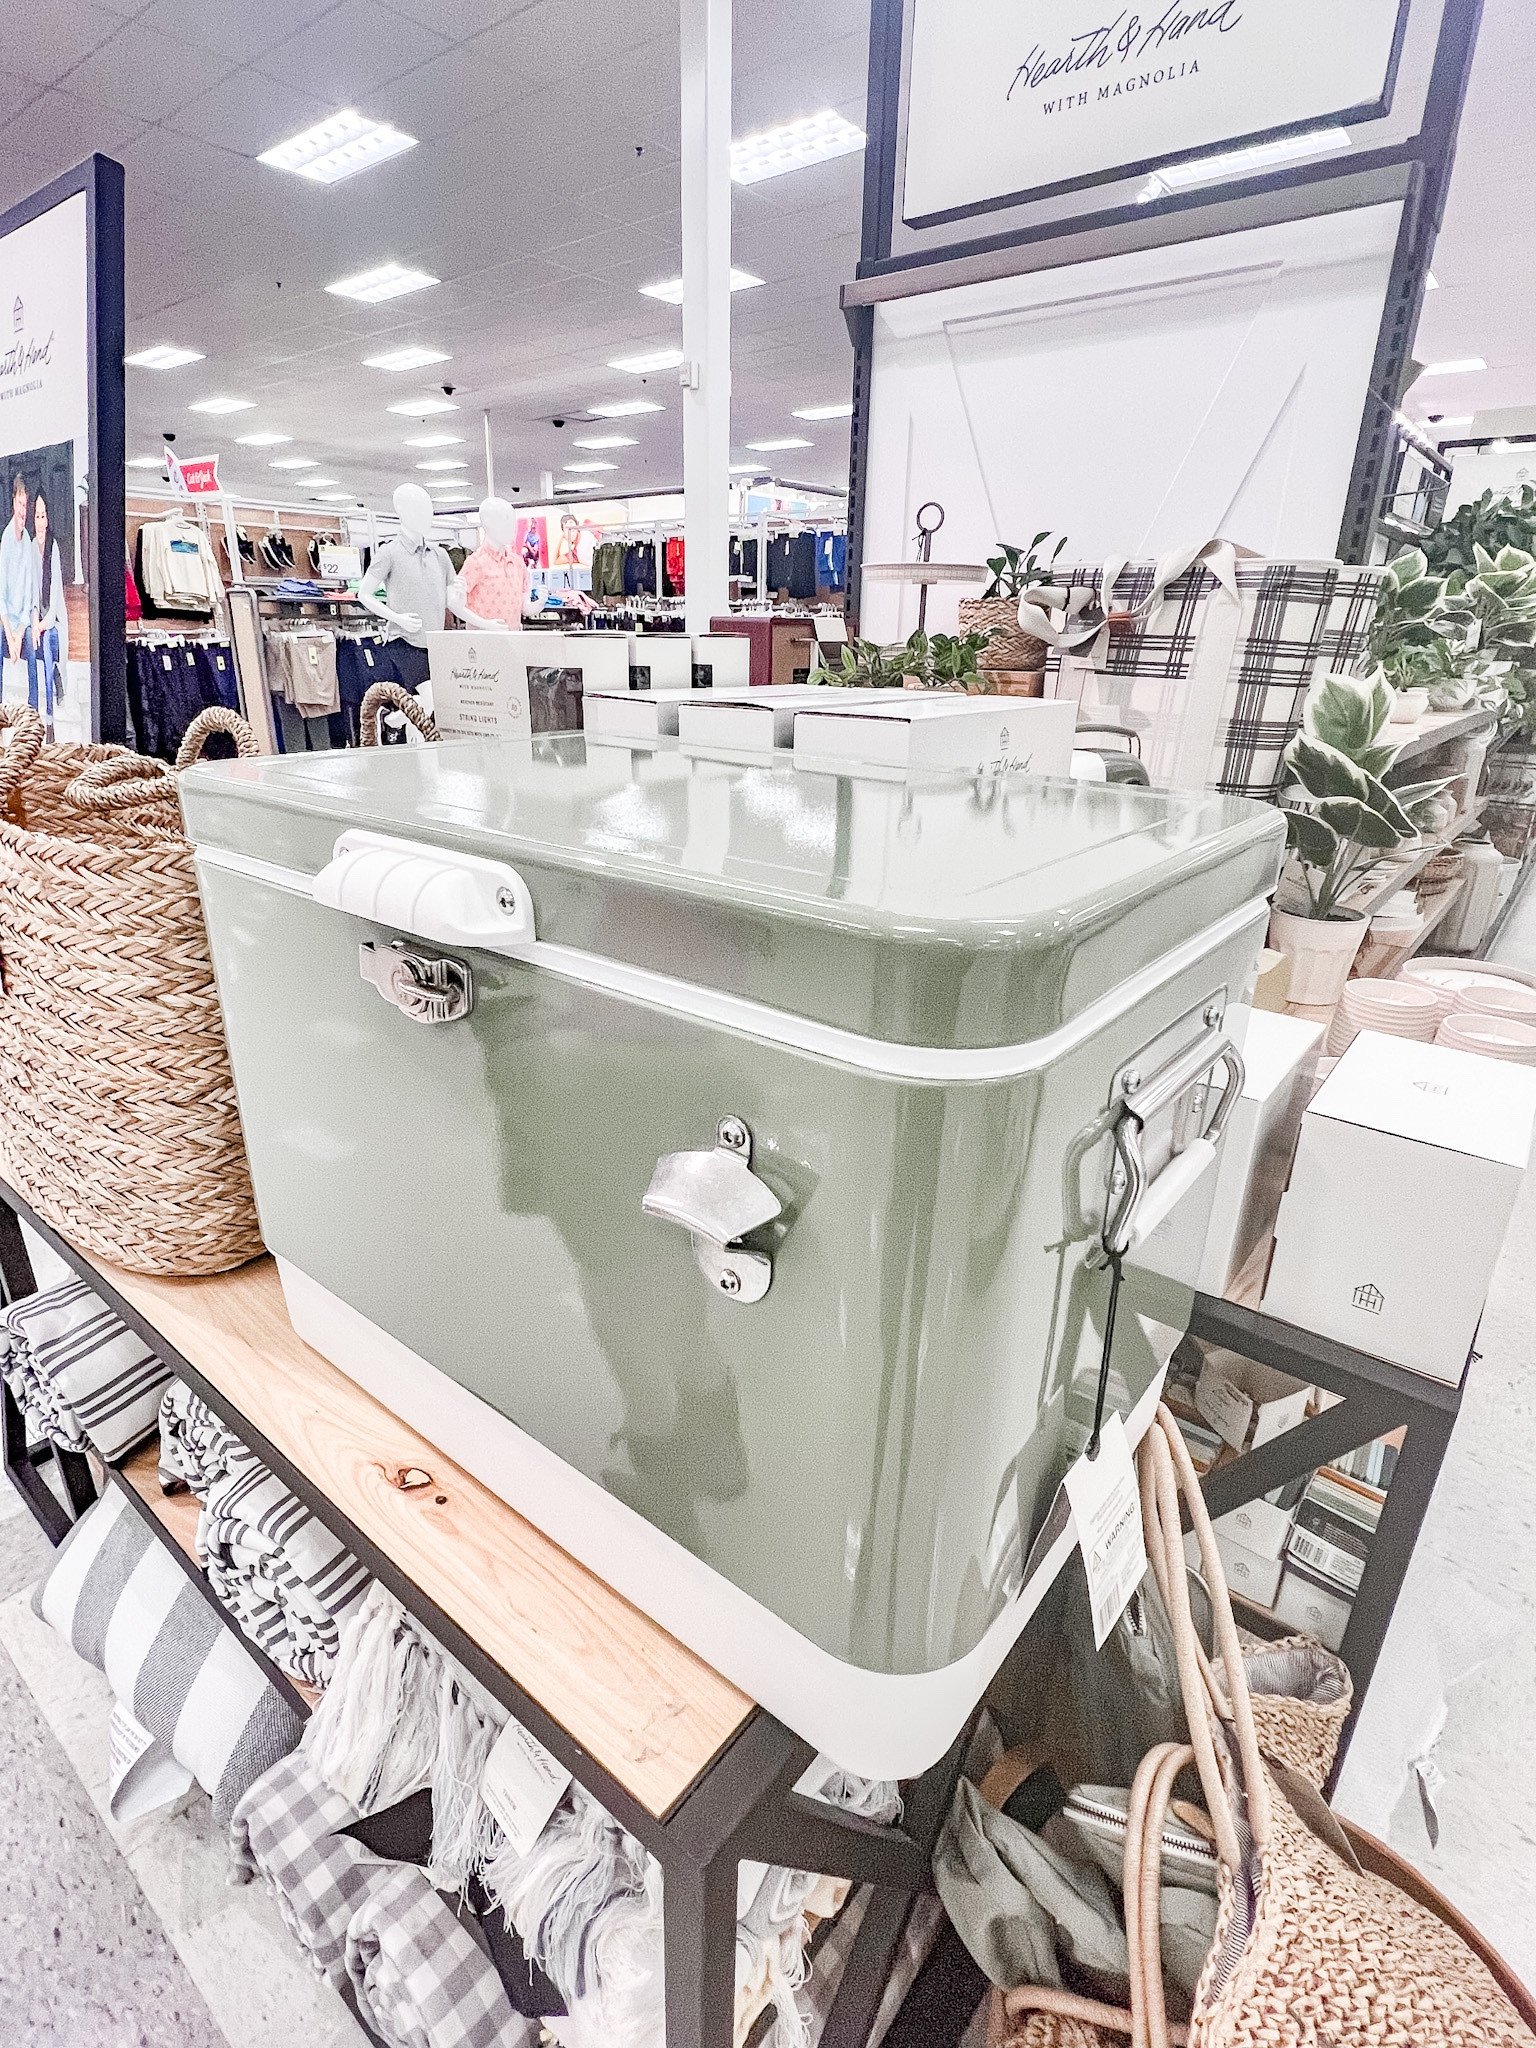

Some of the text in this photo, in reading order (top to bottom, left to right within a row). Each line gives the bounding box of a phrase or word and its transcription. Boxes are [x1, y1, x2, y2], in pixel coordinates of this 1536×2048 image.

[1006, 0, 1244, 101] Hearth & Hand
[1043, 59, 1200, 115] WITH MAGNOLIA
[24, 330, 54, 373] Hand
[323, 563, 338, 574] $22
[478, 668, 500, 682] Hand
[459, 713, 498, 725] STRING LIGHTS
[1010, 752, 1034, 773] Hand
[1104, 1502, 1135, 1550] WARNING
[512, 1724, 541, 1752] Hearth
[536, 1758, 561, 1785] Hand
